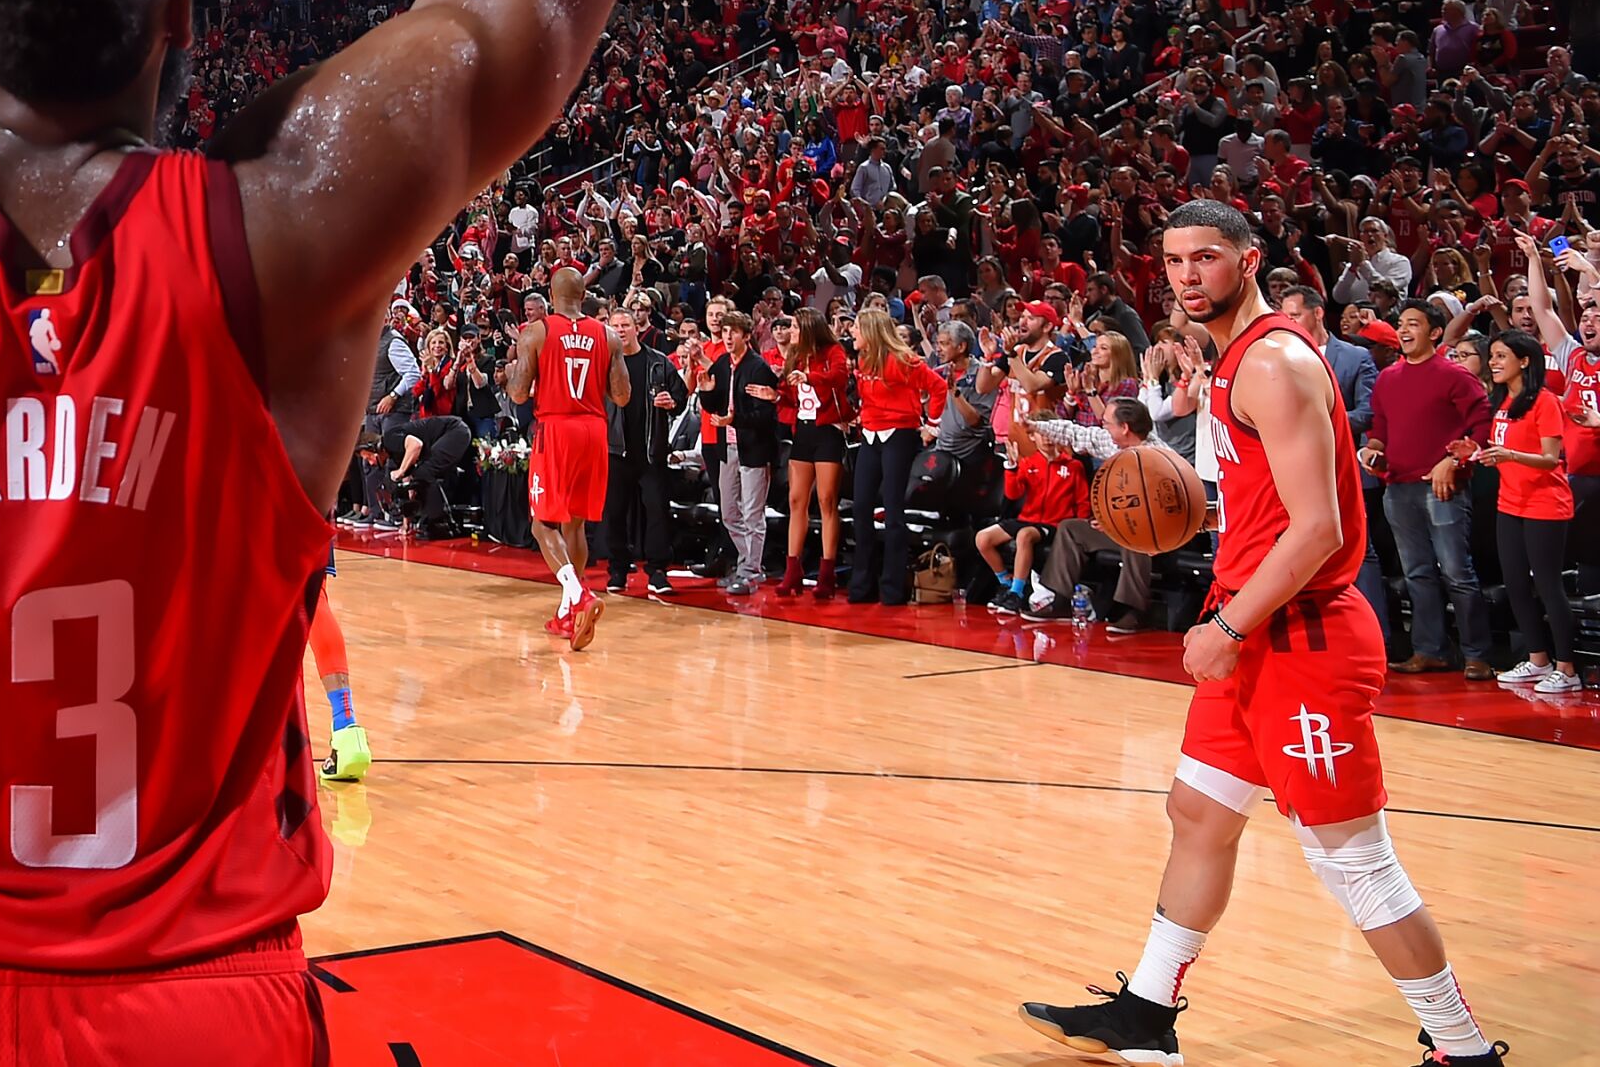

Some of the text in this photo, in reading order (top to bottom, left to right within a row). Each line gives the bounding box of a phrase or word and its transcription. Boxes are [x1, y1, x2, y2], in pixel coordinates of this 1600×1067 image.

[1510, 250, 1523, 267] 15
[560, 334, 595, 352] TUCKER
[565, 357, 590, 400] 17
